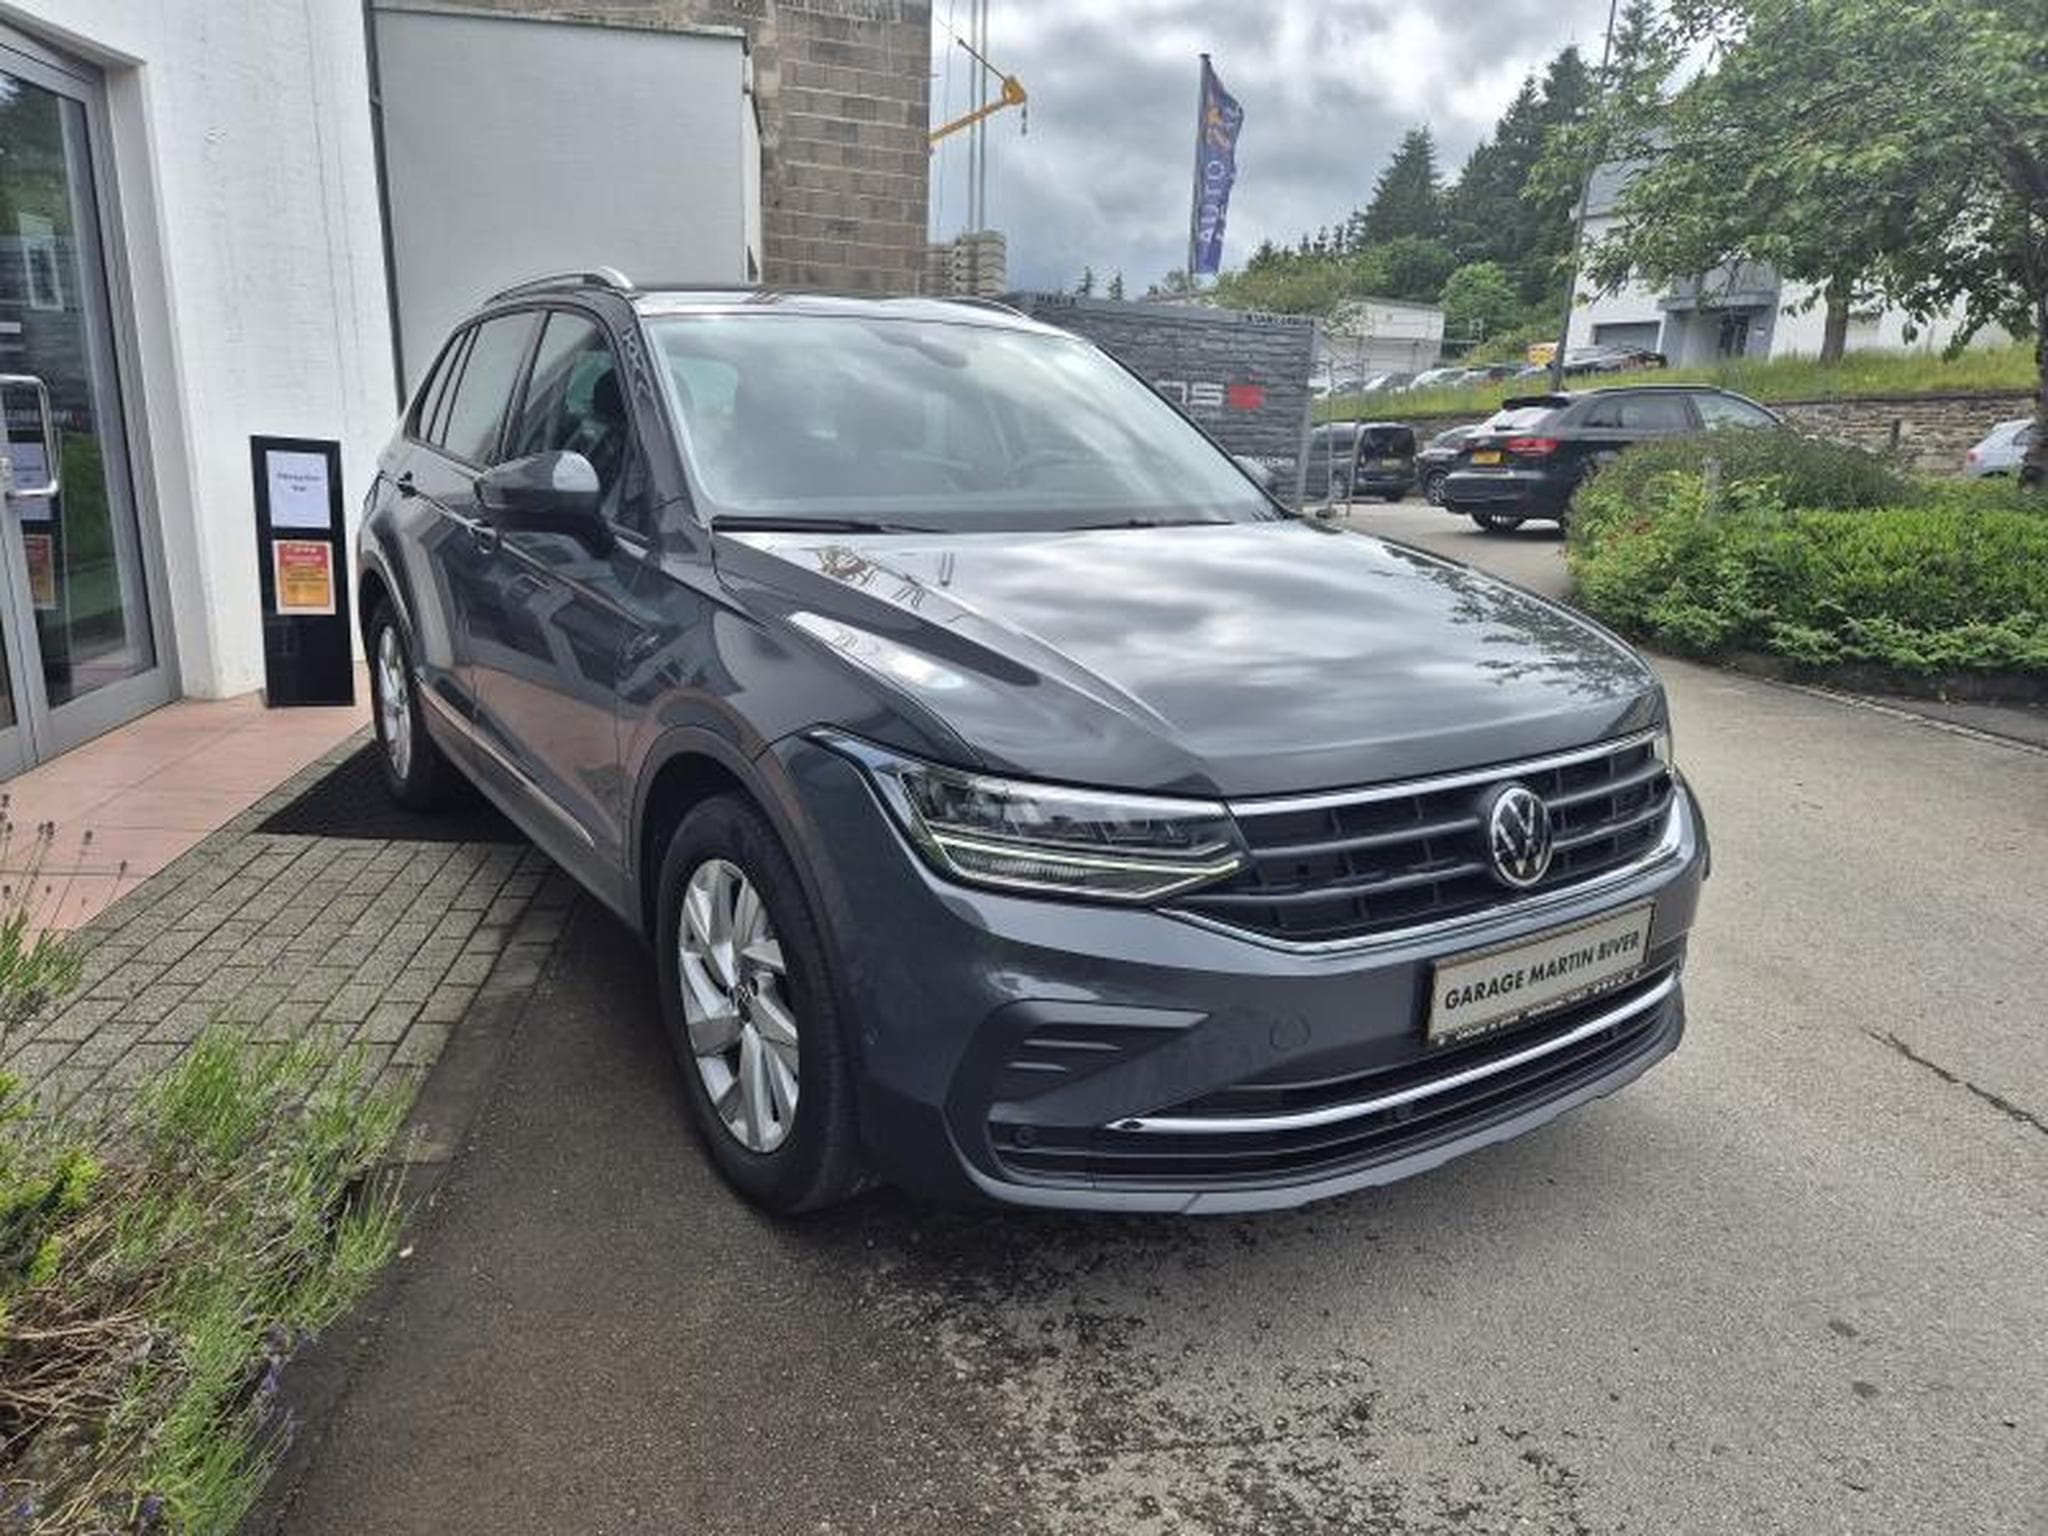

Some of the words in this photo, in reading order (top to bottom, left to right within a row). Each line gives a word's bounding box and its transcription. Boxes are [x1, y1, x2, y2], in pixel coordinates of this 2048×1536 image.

[1199, 160, 1226, 243] AUTO
[1445, 973, 1525, 1010] GARAGE
[1528, 947, 1595, 986] MARTIN
